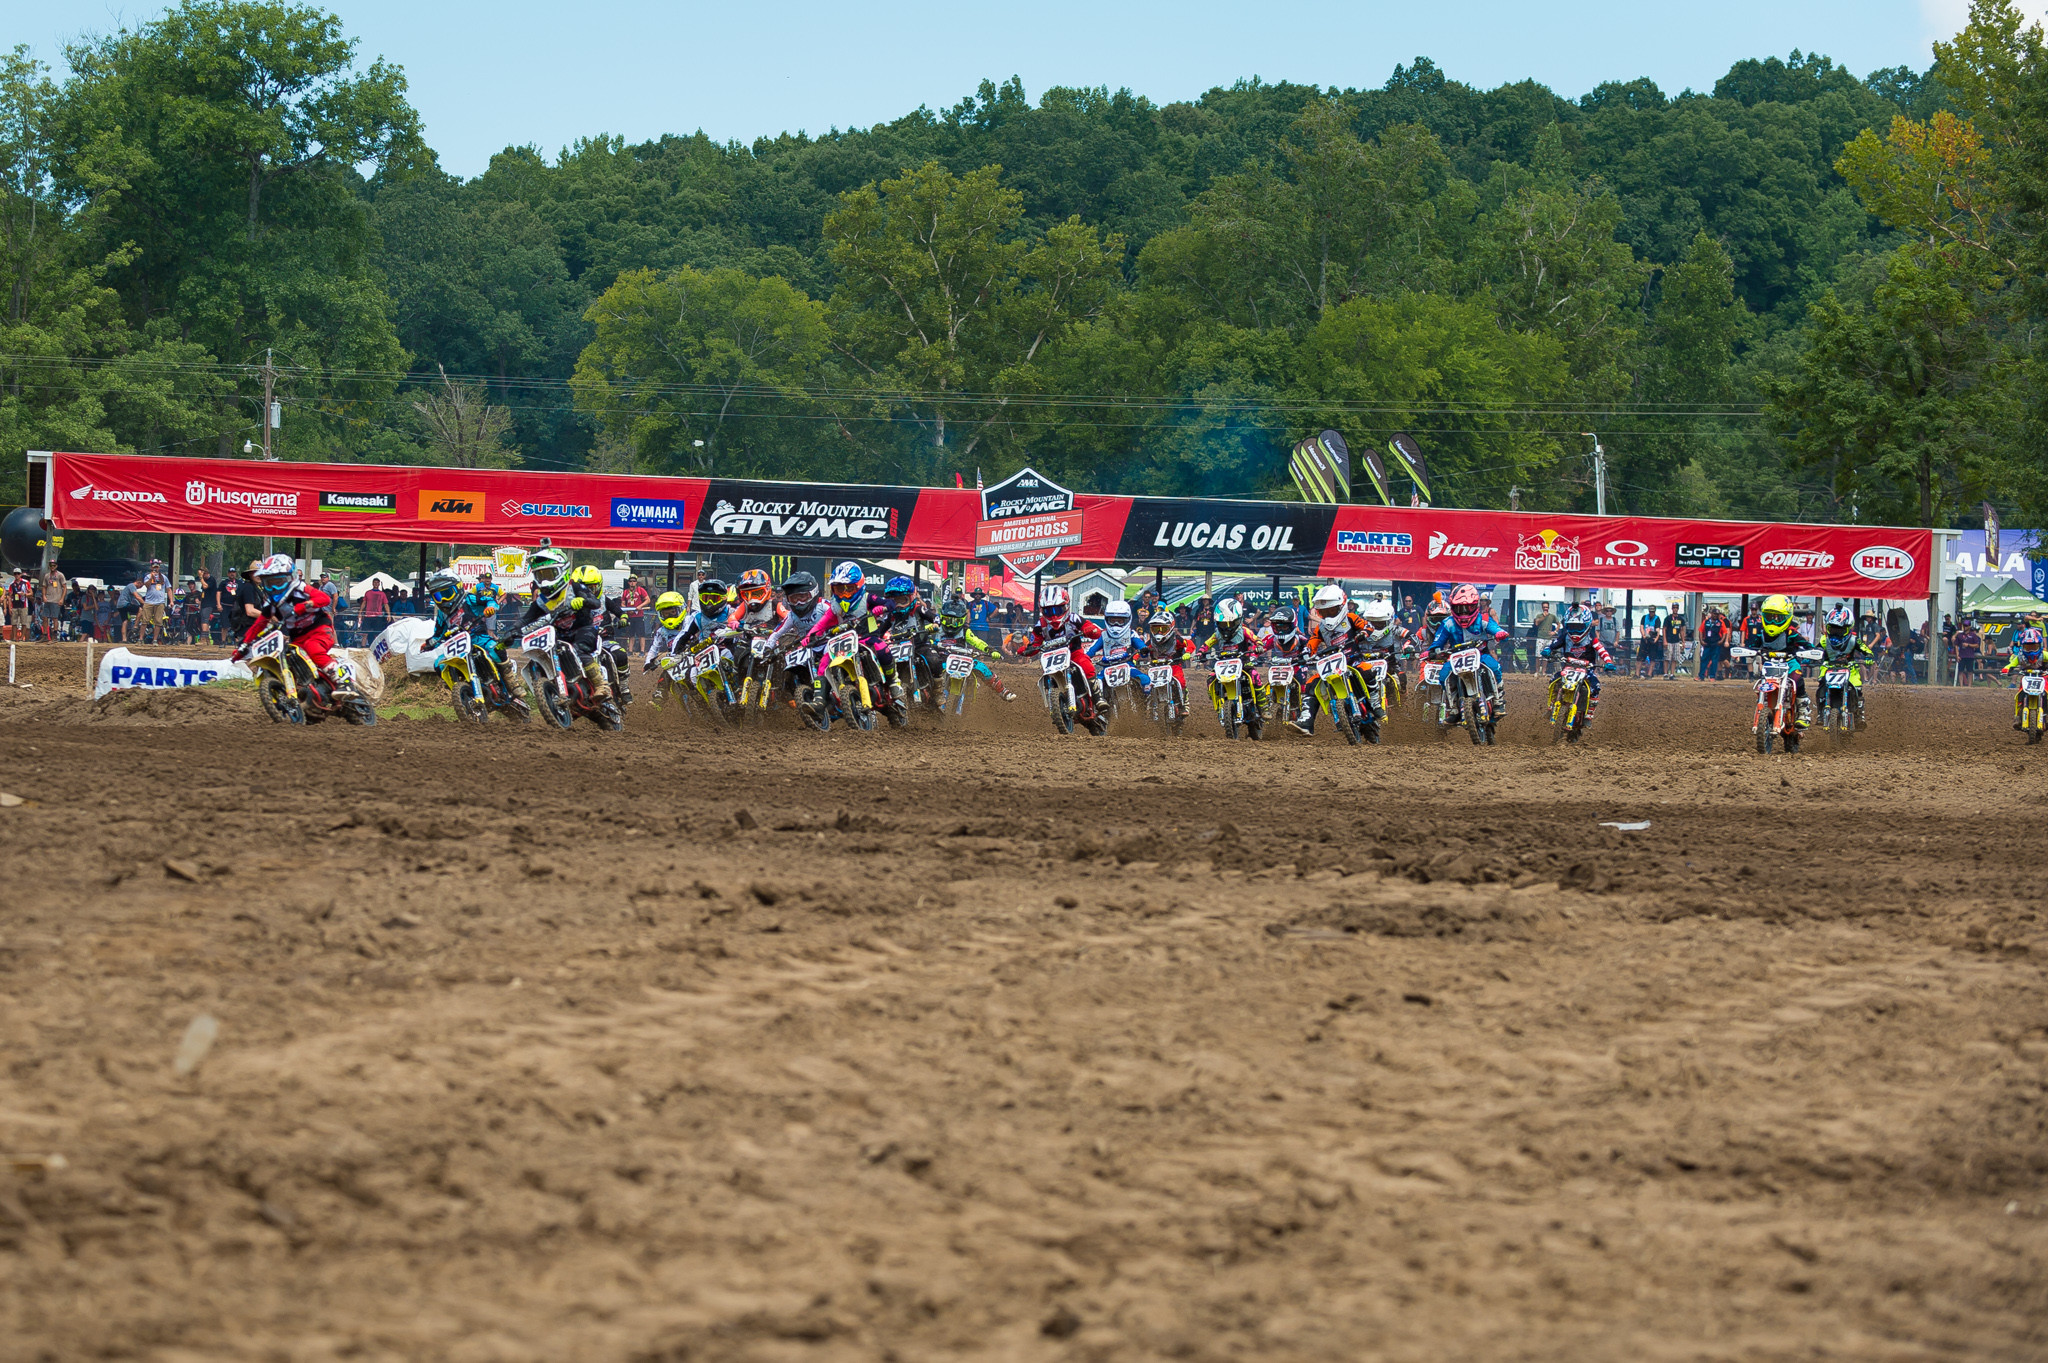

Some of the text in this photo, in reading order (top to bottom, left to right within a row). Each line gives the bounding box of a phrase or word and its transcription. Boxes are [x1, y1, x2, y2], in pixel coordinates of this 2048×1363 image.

[92, 490, 168, 503] HONDA
[208, 488, 298, 507] Husqvarna
[328, 494, 388, 506] Kawasaki
[430, 499, 473, 514] KTM
[521, 503, 590, 518] SUZUKI
[631, 505, 677, 519] YAMAHA
[1003, 515, 1056, 527] AMATEUR NATIONAL
[990, 521, 1068, 543] MOTOCROSS
[1154, 521, 1294, 551] LUCAS OIL
[1338, 531, 1411, 546] PARTS
[980, 543, 1025, 554] CHAMPIONSHIP
[1034, 538, 1058, 547] LORETTA
[1338, 543, 1411, 554] UNLIMITED
[1443, 543, 1499, 558] thor
[1678, 546, 1741, 559] GoPro
[1013, 555, 1034, 565] LUCAS
[1516, 552, 1580, 571] Red Bull
[1594, 556, 1658, 567] OAKLEY
[1760, 550, 1835, 567] COMETIC
[1862, 556, 1903, 569] BELL
[446, 638, 467, 656] 55
[949, 659, 972, 672] 82
[1045, 654, 1066, 668] 18
[1322, 658, 1343, 674] 47
[1153, 670, 1167, 680] 14
[1219, 664, 1238, 674] 73
[1272, 671, 1289, 680] 23
[112, 666, 218, 687] PARTS
[1109, 670, 1126, 683] 54
